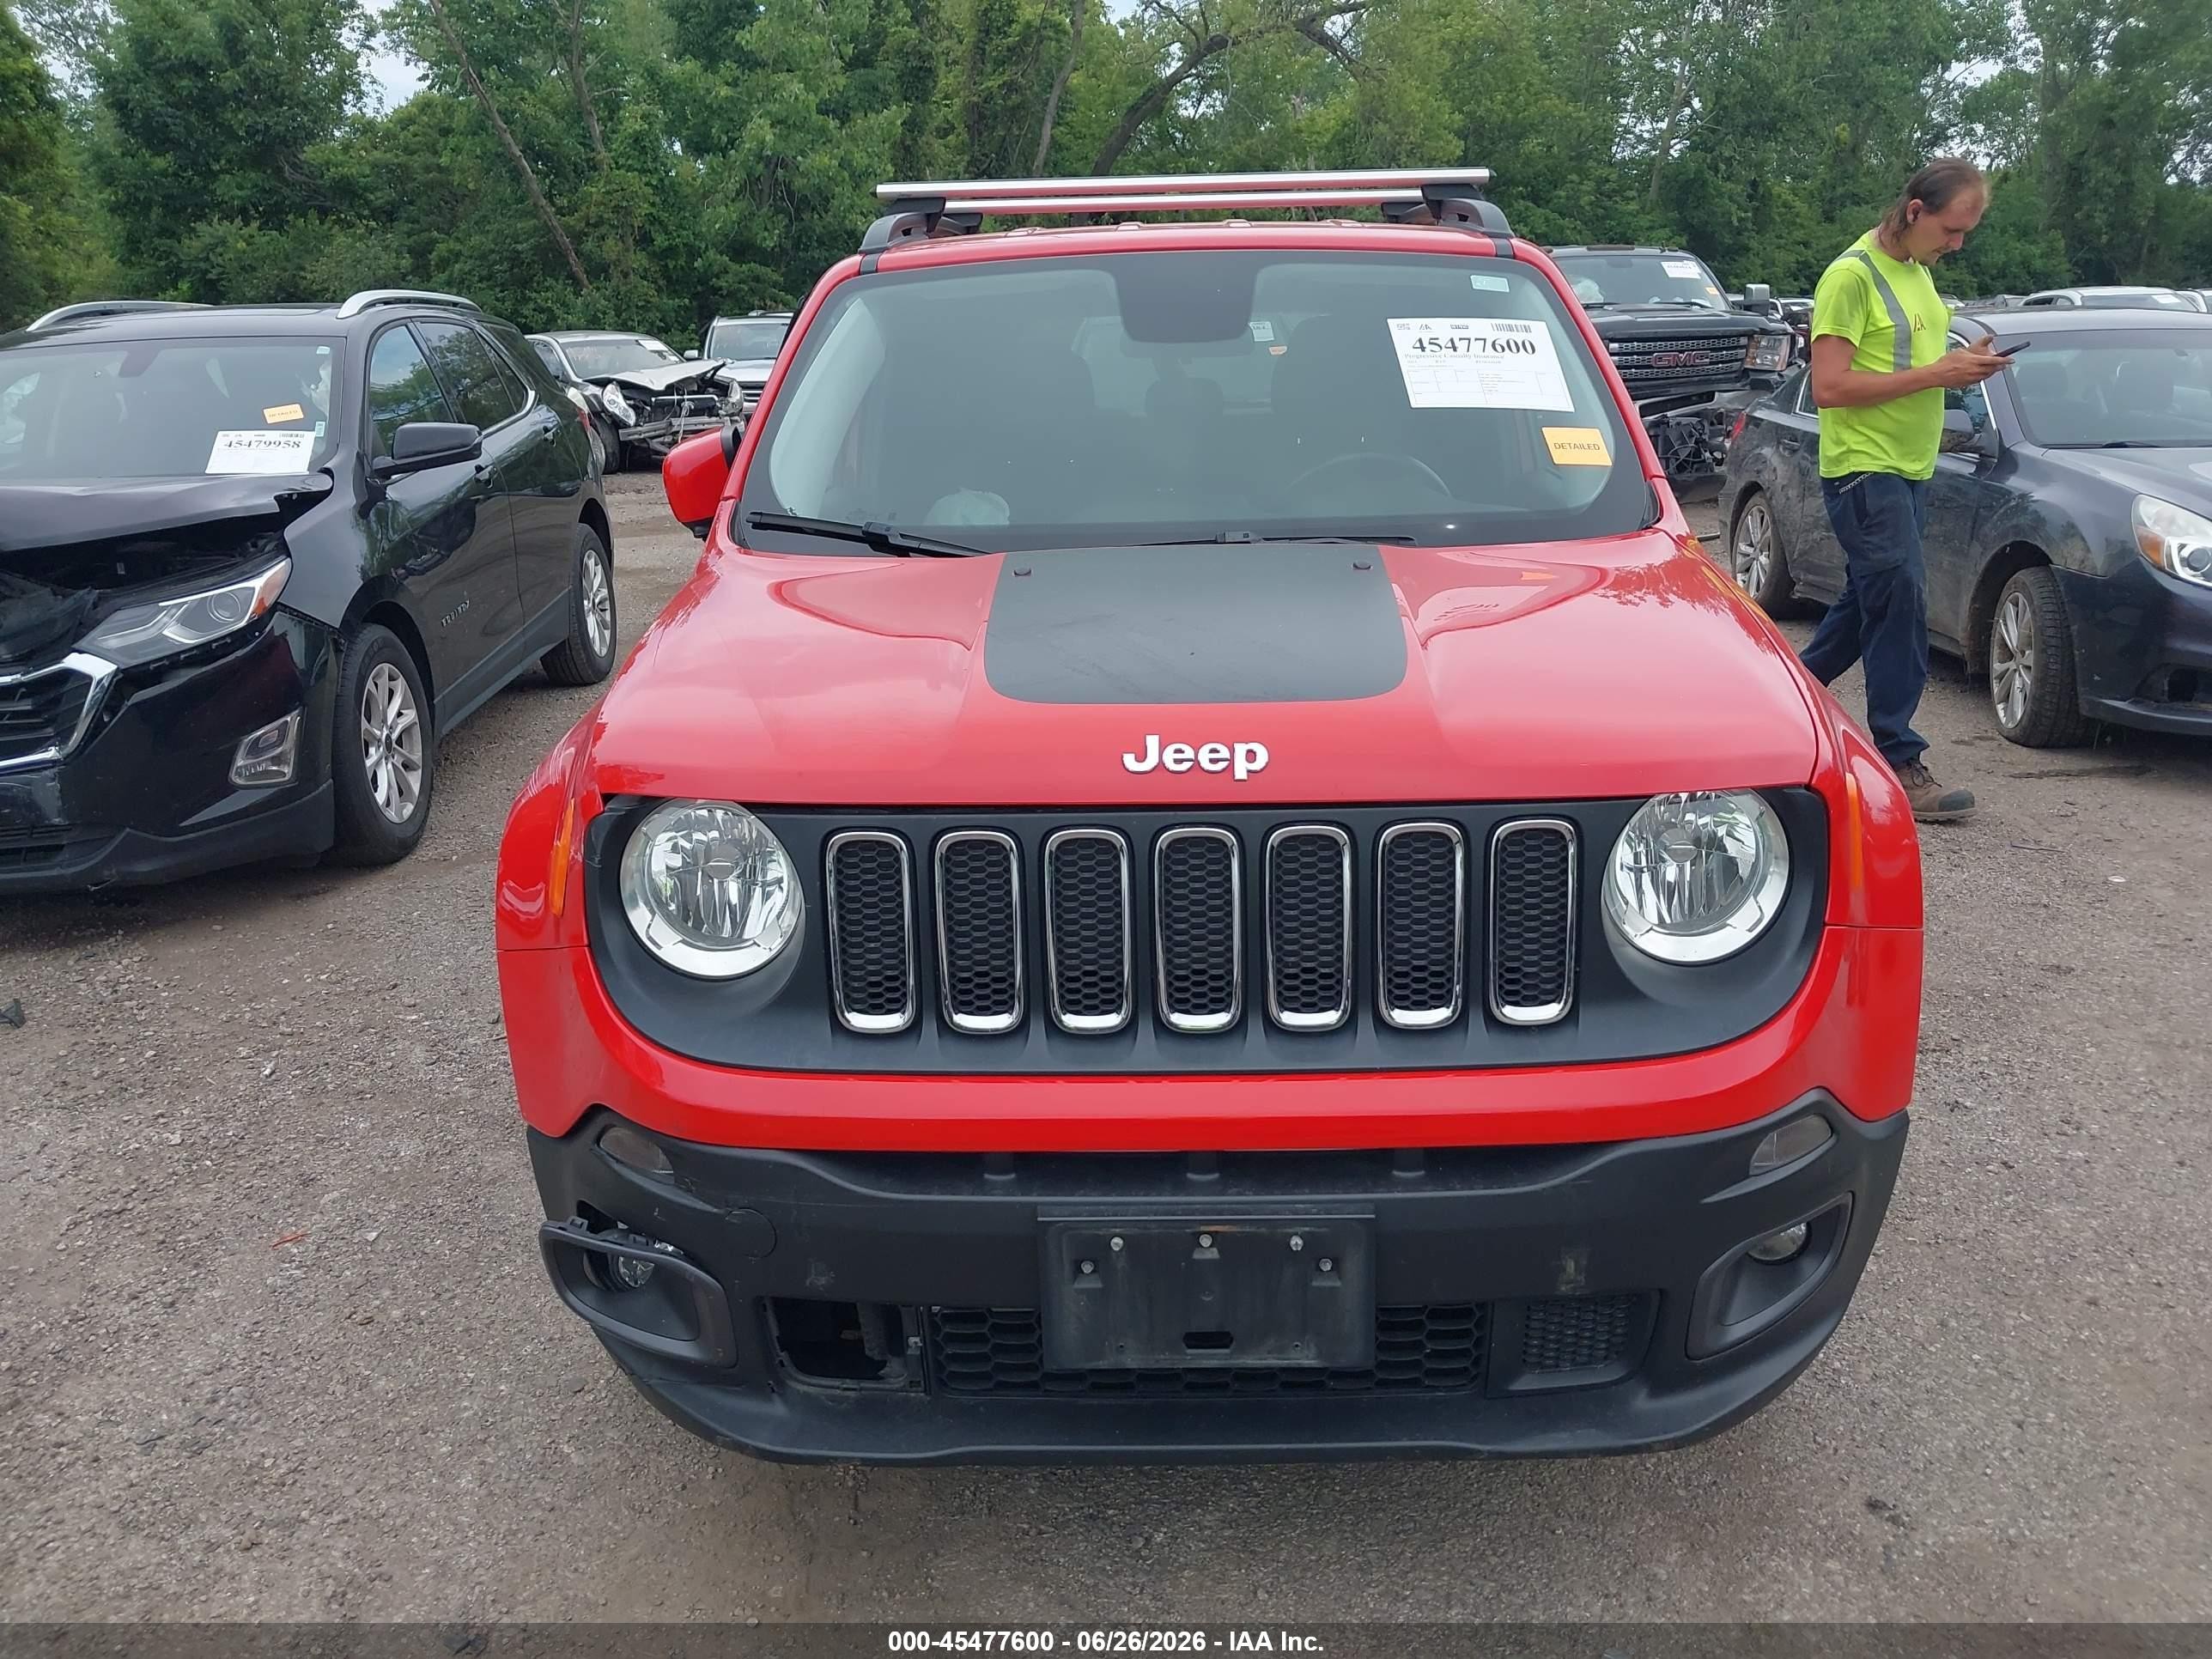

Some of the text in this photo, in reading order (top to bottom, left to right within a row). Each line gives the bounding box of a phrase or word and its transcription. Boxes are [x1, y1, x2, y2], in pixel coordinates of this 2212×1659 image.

[1412, 337, 1536, 355] 45477600
[1652, 350, 1711, 368] GMC
[224, 440, 301, 448] 45479958
[1553, 441, 1601, 452] DETAILED
[1122, 733, 1269, 781] Jeep
